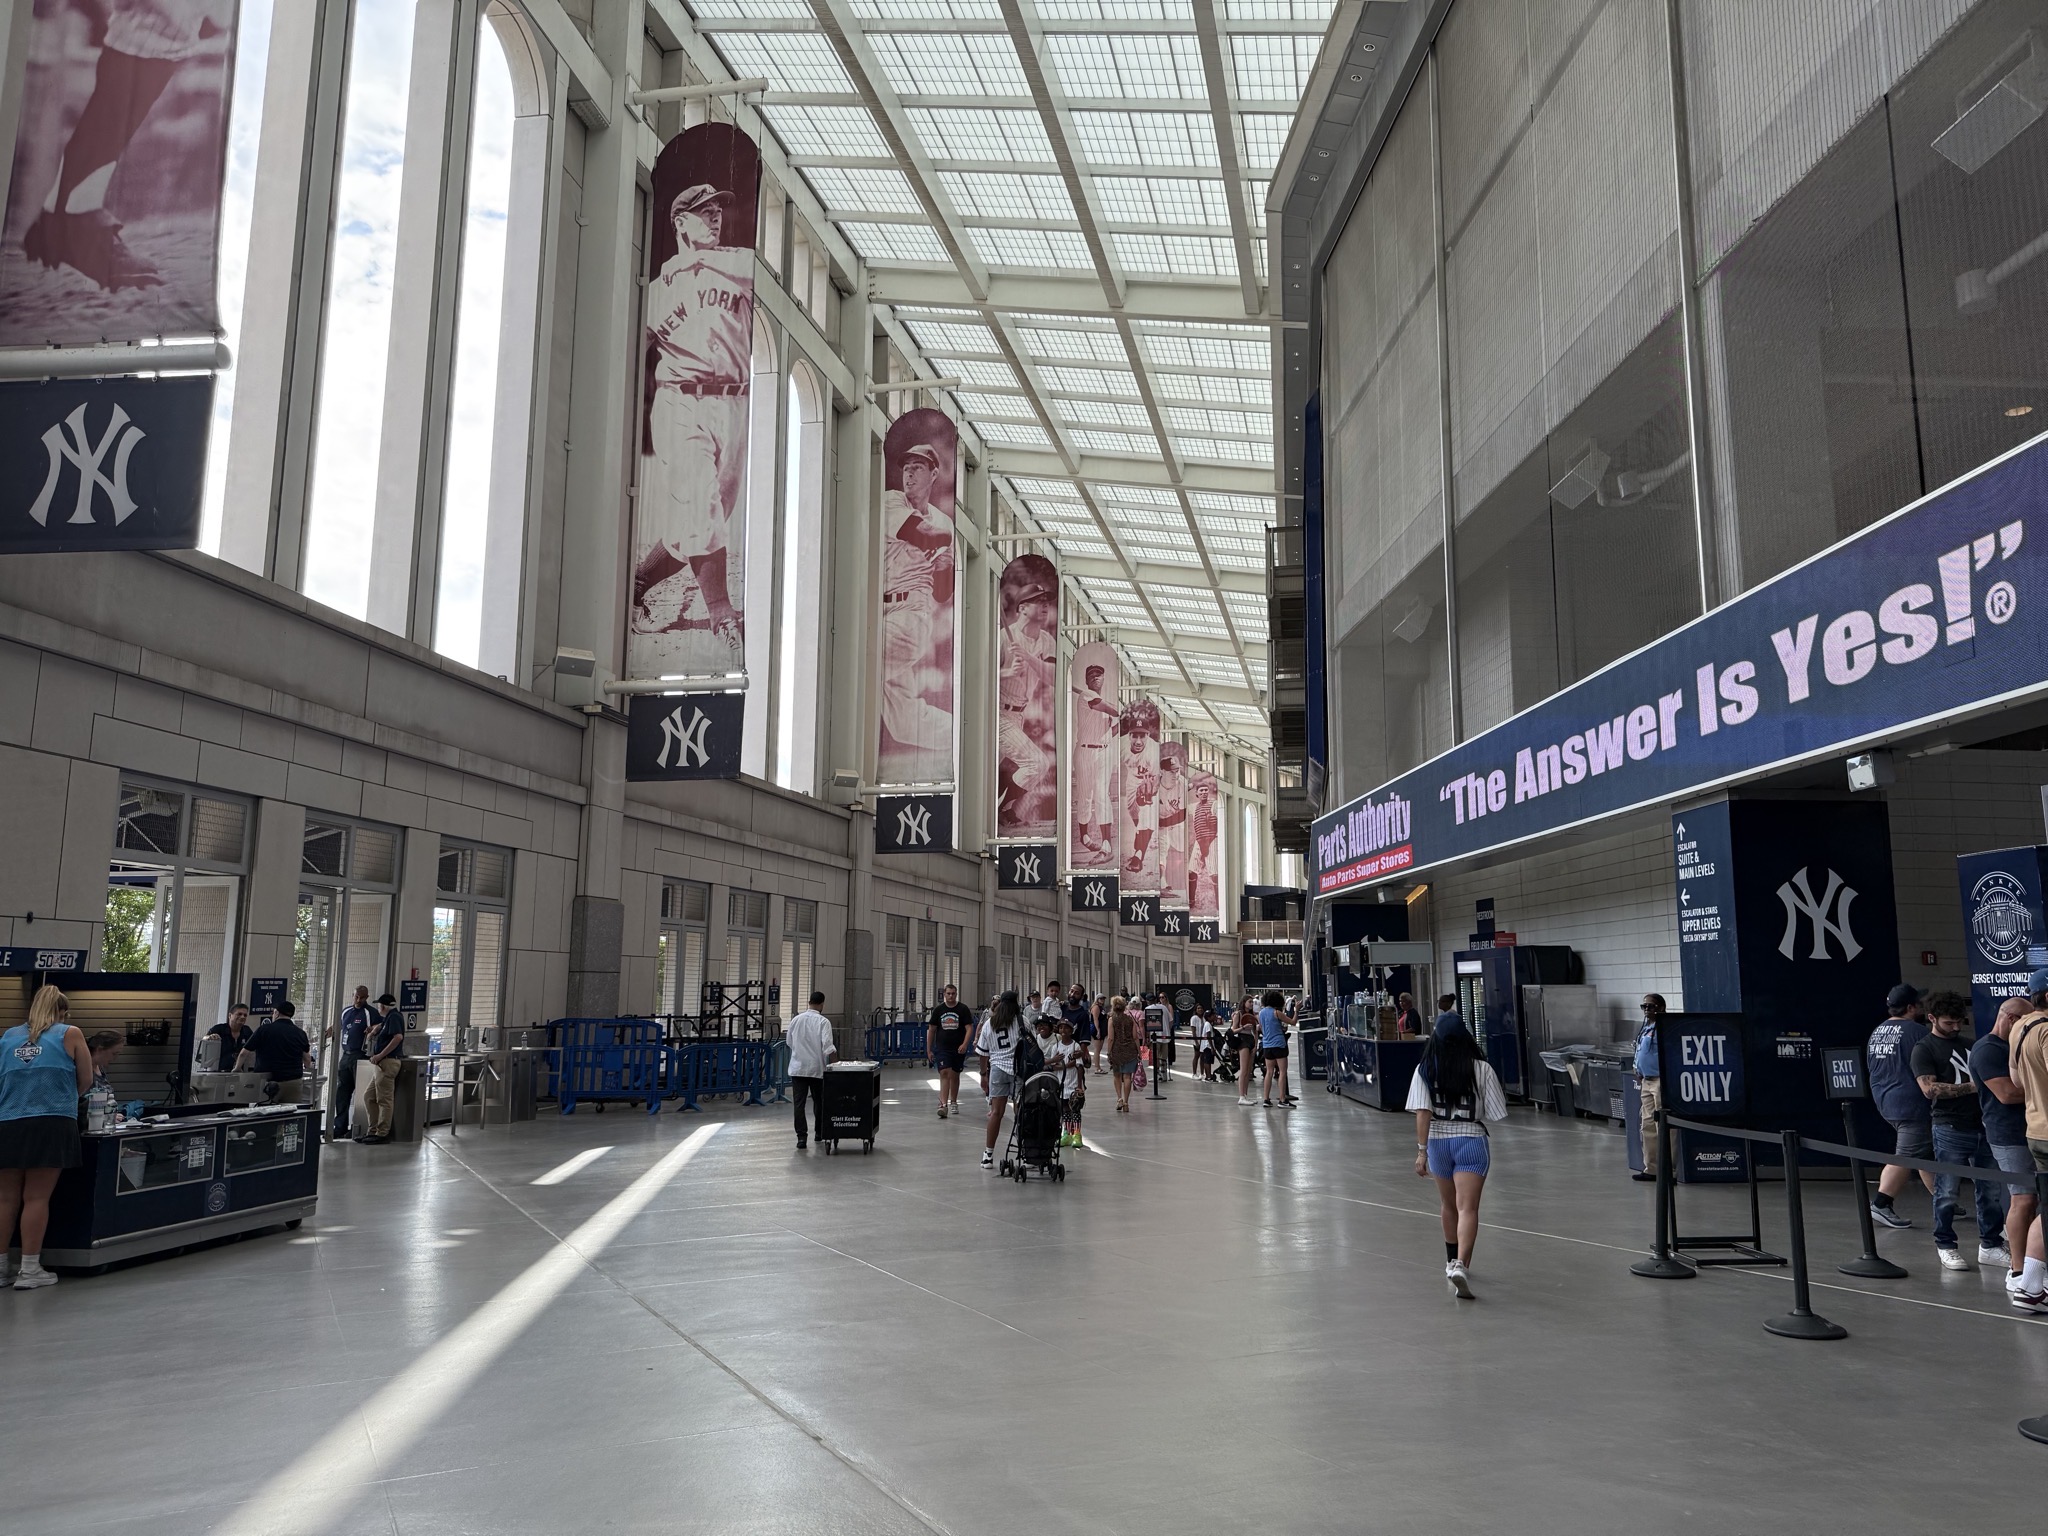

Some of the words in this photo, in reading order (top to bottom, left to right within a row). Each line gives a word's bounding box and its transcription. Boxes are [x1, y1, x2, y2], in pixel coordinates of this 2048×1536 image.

[657, 302, 689, 342] NEW
[1514, 689, 1684, 804] Answer
[1697, 661, 1759, 737] Is
[1318, 823, 1346, 872] Parts
[1348, 791, 1411, 859] Authority
[1678, 841, 1697, 852] ESCALATOR
[1678, 852, 1694, 866] SUITE
[1695, 851, 1699, 863] &
[1321, 877, 1337, 888] Auto
[1337, 868, 1355, 884] Parts
[1356, 859, 1380, 877] Super
[1380, 851, 1410, 871] Stores
[1679, 866, 1695, 880] MAIN
[1695, 863, 1715, 877] LEVELS
[1682, 908, 1701, 917] ESCALATOR
[1705, 906, 1718, 915] STAIRS
[1682, 919, 1701, 932] UPPER
[1701, 917, 1721, 930] LEVELS
[1708, 932, 1718, 940] SUITE
[1972, 973, 1994, 984] JERSEY
[1990, 986, 2008, 997] TEAM
[997, 1028, 1011, 1049] 2
[1681, 1035, 1727, 1066] EXIT
[1832, 1060, 1853, 1073] EXIT
[1680, 1071, 1732, 1102] ONLY
[1832, 1075, 1857, 1088] ONLY
